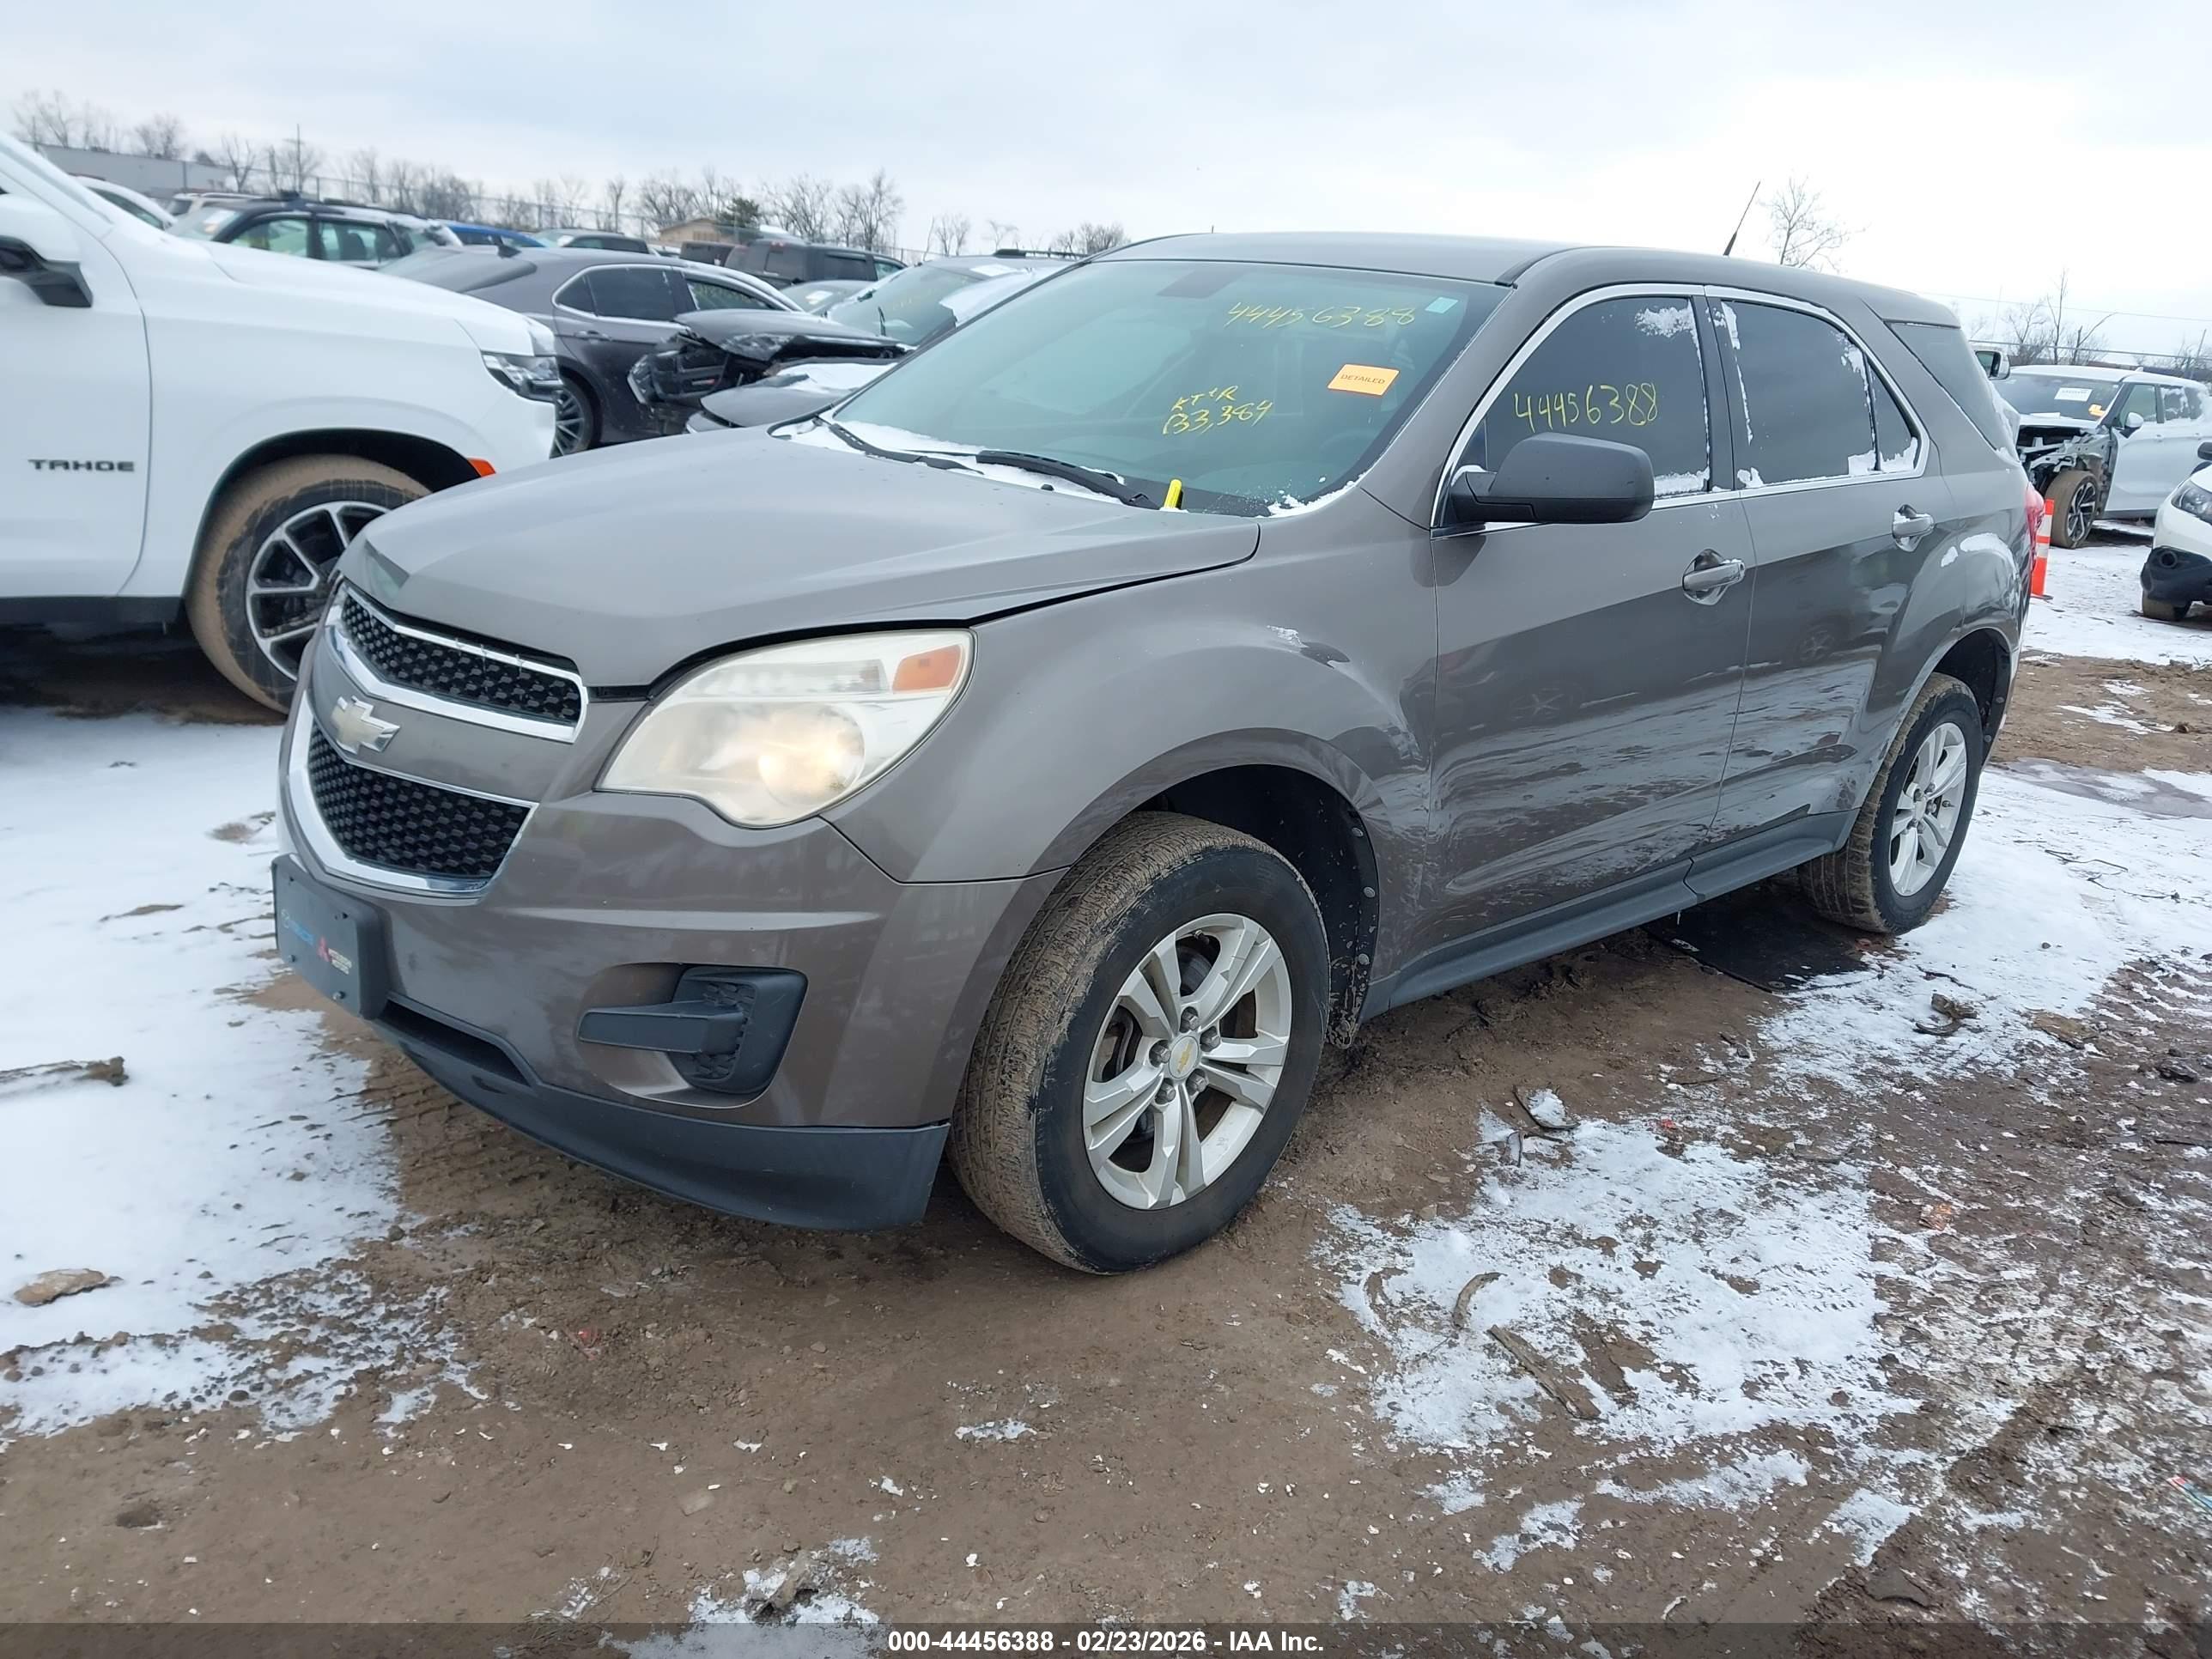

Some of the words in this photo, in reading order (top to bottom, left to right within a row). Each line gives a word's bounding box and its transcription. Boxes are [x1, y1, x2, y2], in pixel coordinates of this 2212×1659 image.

[1225, 301, 1415, 328] 44456388
[1340, 374, 1385, 384] DETAILED
[1514, 382, 1658, 433] 44456388
[27, 459, 135, 472] TAHOE
